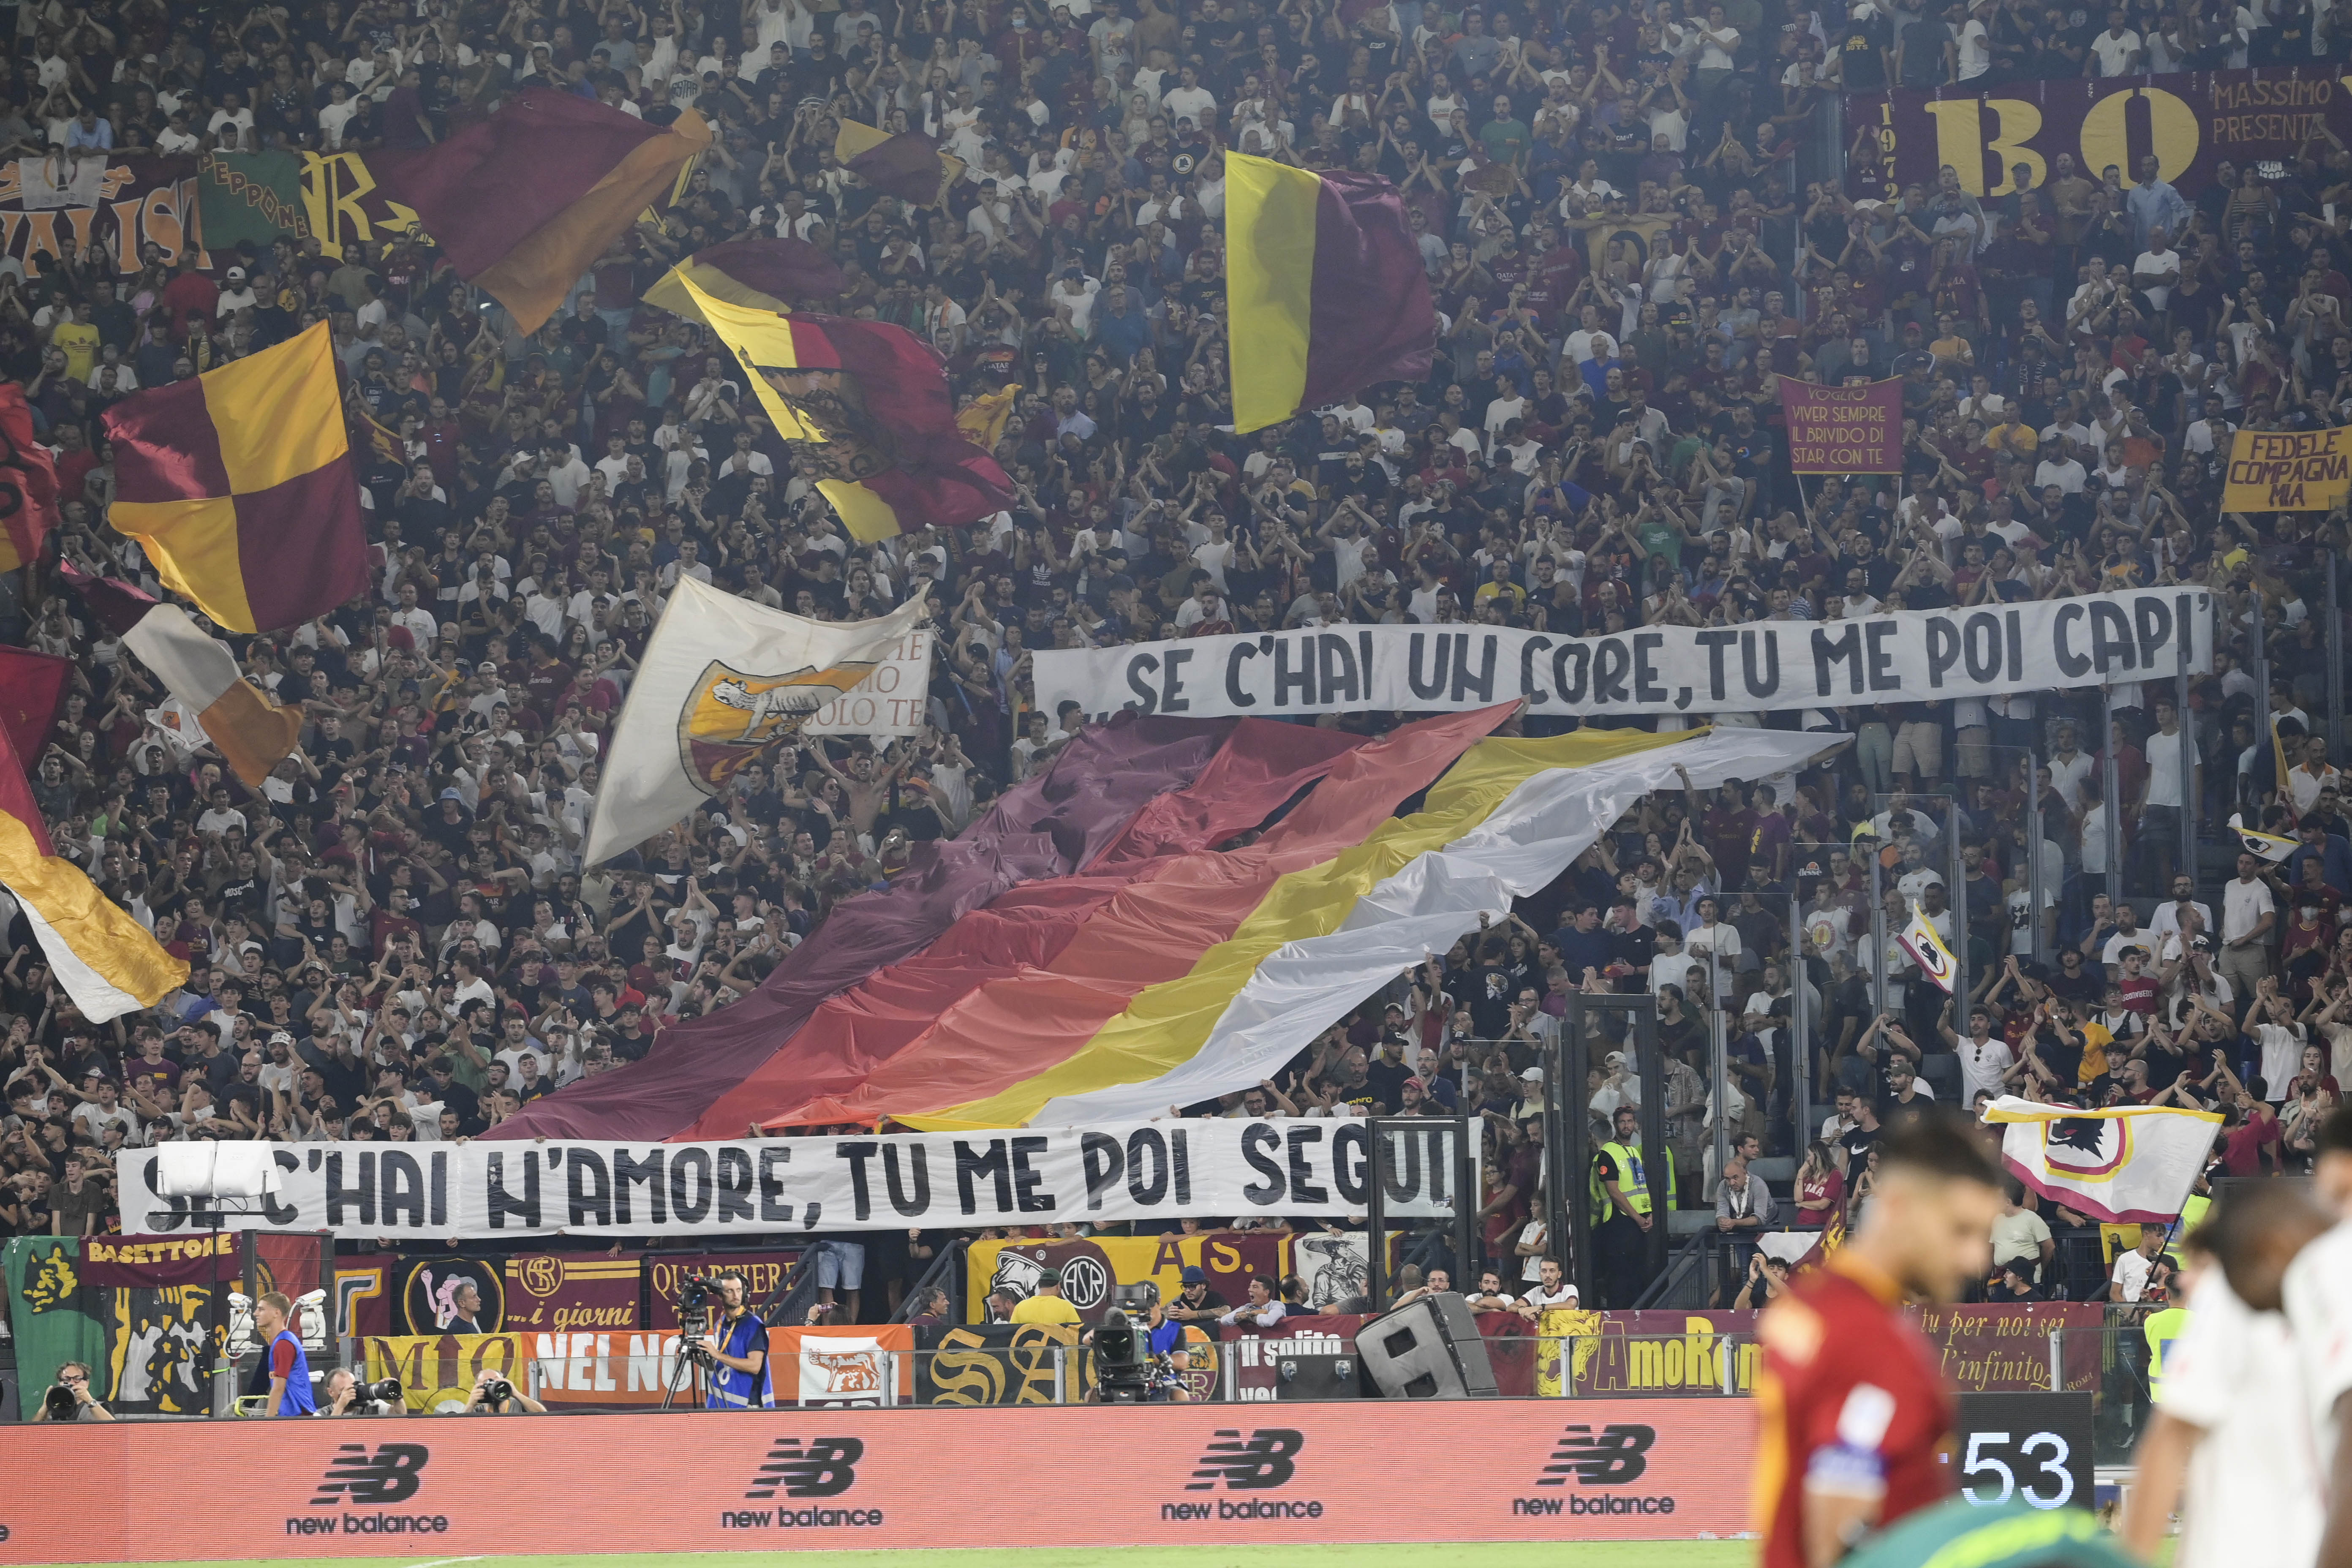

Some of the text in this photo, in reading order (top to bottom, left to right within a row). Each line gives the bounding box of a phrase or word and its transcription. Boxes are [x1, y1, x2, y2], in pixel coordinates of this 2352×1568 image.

[2213, 79, 2333, 109] MASSIMO
[1615, 133, 1633, 142] OMMY
[1881, 103, 1900, 205] 1972
[197, 152, 308, 240] PEPPONE
[1808, 387, 1867, 401] VOGLIO
[1792, 406, 1886, 422] VIVER SEMPRE
[1792, 426, 1884, 443] IL BRIVIDO DI
[2250, 430, 2342, 460] FEDELE
[1792, 447, 1884, 464] STAR CON TE
[2229, 454, 2348, 484] COMPAGNA
[2268, 483, 2306, 507] MIA
[1123, 647, 1194, 716] SE
[1225, 630, 1372, 707] C'HAI
[1521, 632, 1693, 710] CORE,
[1695, 629, 1781, 701] TU
[1811, 620, 1901, 697] ME
[1925, 609, 2023, 689] POI
[2053, 591, 2211, 678] CAPI'
[887, 699, 922, 727] TE
[836, 1141, 932, 1222] TU
[954, 1135, 1056, 1216] ME
[1081, 1125, 1191, 1211] POI
[1241, 1121, 1446, 1205] SEGUI
[88, 1232, 234, 1265] BASETTONE
[553, 1300, 636, 1332] giorni
[1920, 1307, 2067, 1346] tu per noi sei
[536, 1333, 716, 1392] NEL NO
[1241, 1334, 1259, 1367] il
[1940, 1348, 2044, 1391] l'infinito
[721, 1505, 883, 1528] new balance
[1161, 1497, 1324, 1521] new balance
[1512, 1494, 1675, 1516] new balance
[286, 1511, 449, 1535] new balance
